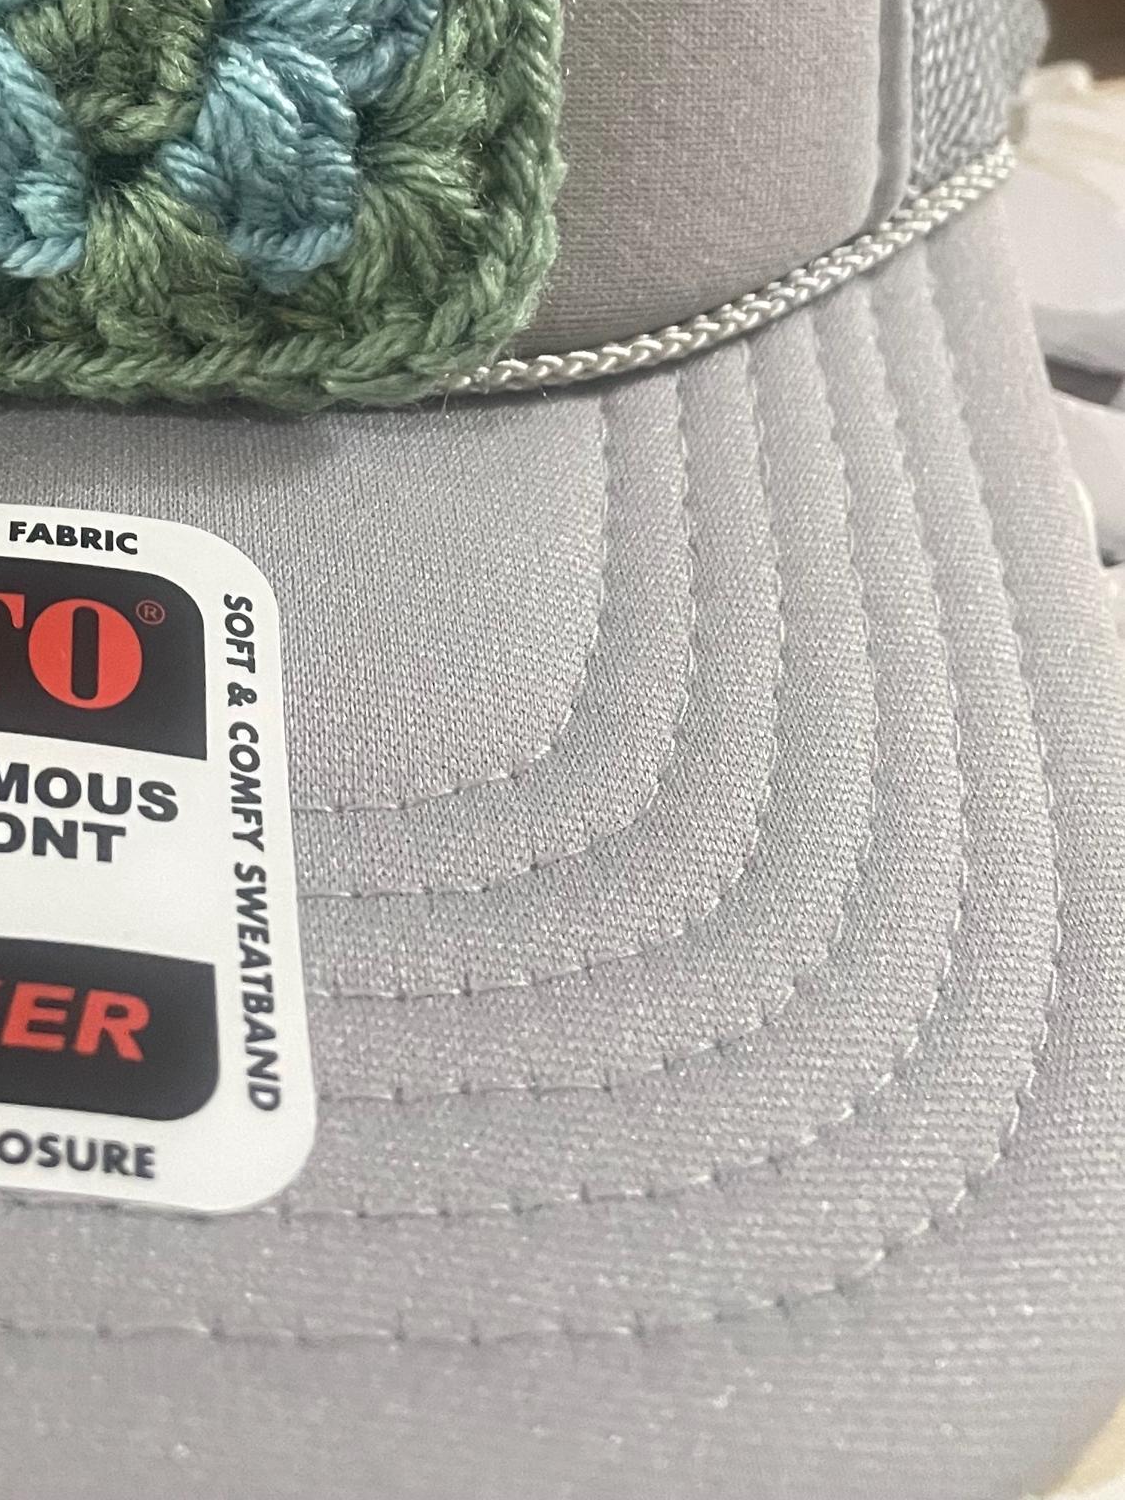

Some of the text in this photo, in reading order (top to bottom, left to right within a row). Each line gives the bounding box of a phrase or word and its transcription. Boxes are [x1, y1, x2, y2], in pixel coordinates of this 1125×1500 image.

[9, 520, 138, 556] FABRIC
[223, 593, 280, 1112] SOFT & COMFY SWEATBAND
